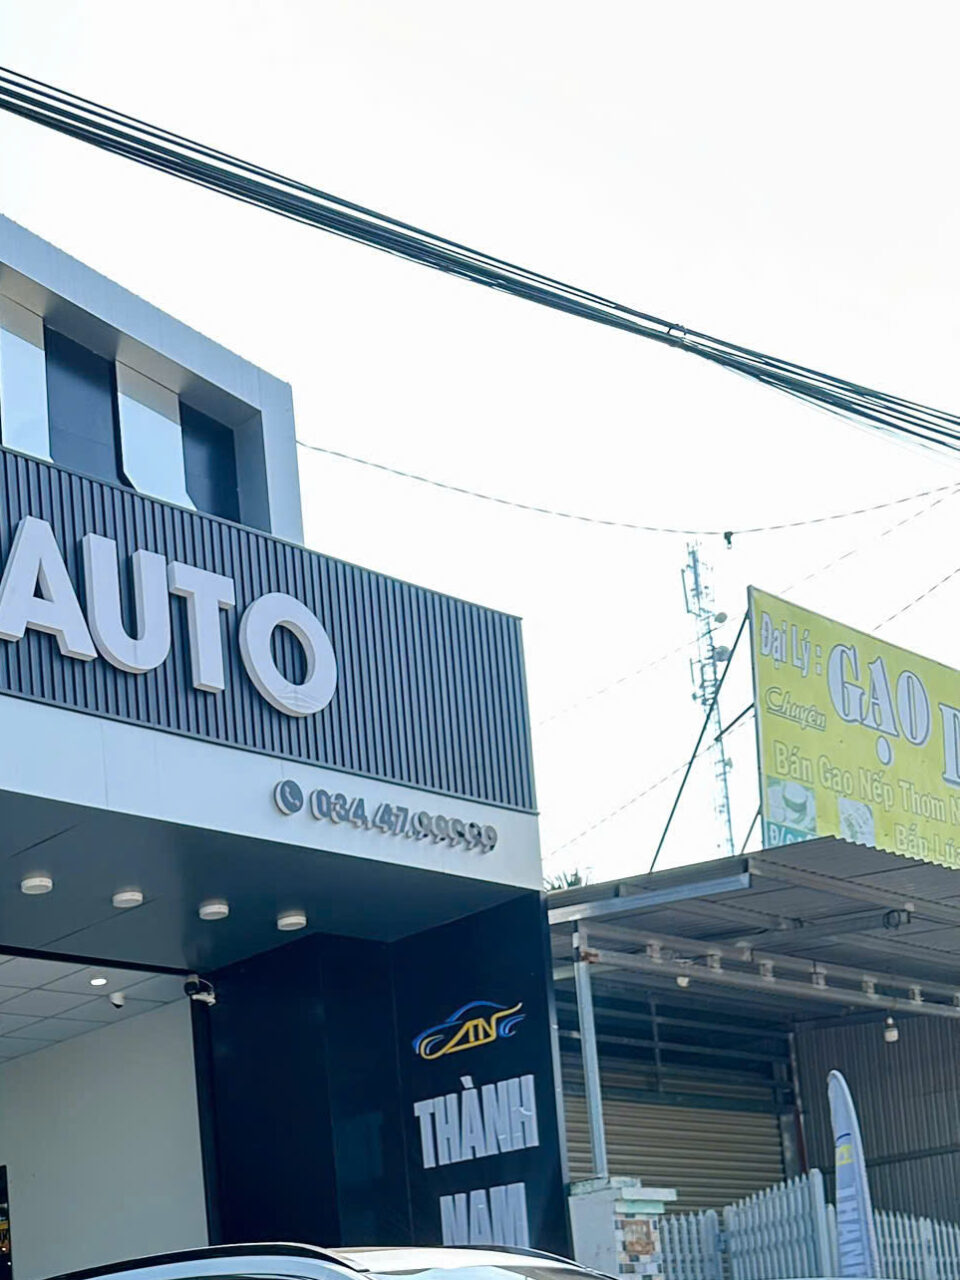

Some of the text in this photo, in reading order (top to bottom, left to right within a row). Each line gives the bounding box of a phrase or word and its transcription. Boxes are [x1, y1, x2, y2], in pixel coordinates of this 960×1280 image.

[827, 643, 930, 766] GẠO
[773, 740, 814, 784] Bán
[413, 1075, 539, 1168] THÀNH
[440, 1182, 530, 1246] NAM
